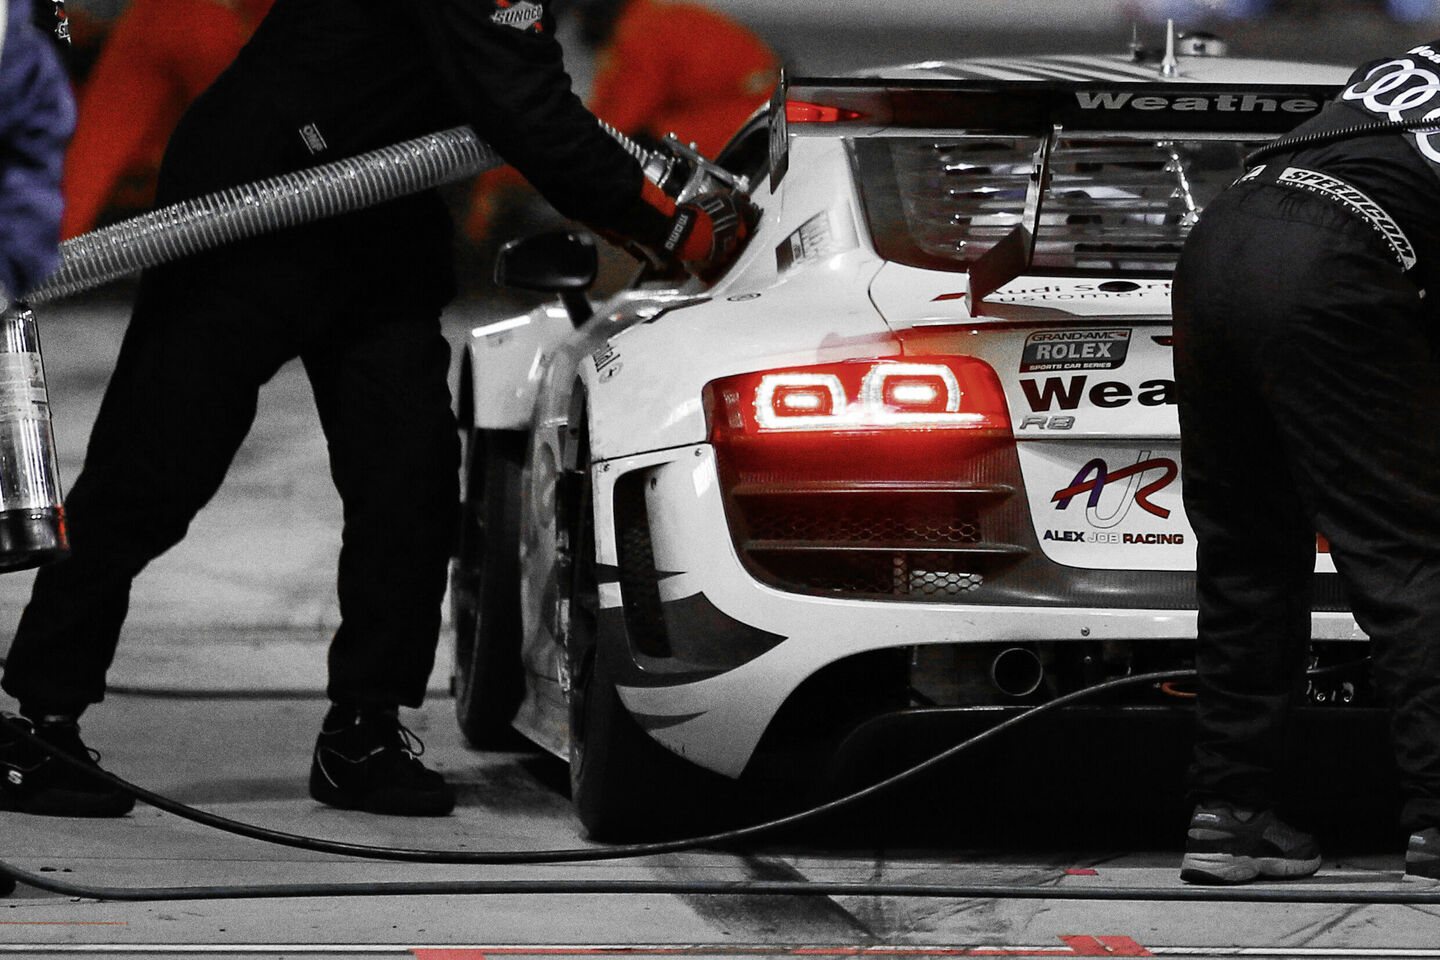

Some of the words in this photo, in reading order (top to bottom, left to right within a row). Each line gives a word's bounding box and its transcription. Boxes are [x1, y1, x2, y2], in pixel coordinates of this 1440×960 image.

[1036, 342, 1113, 360] ROLEX
[1029, 363, 1062, 371] SPORTS
[1083, 361, 1112, 369] SERIES
[1018, 415, 1076, 430] R8
[1043, 529, 1085, 543] ALEX
[1087, 531, 1119, 544] JOB
[1122, 533, 1184, 545] RACING
